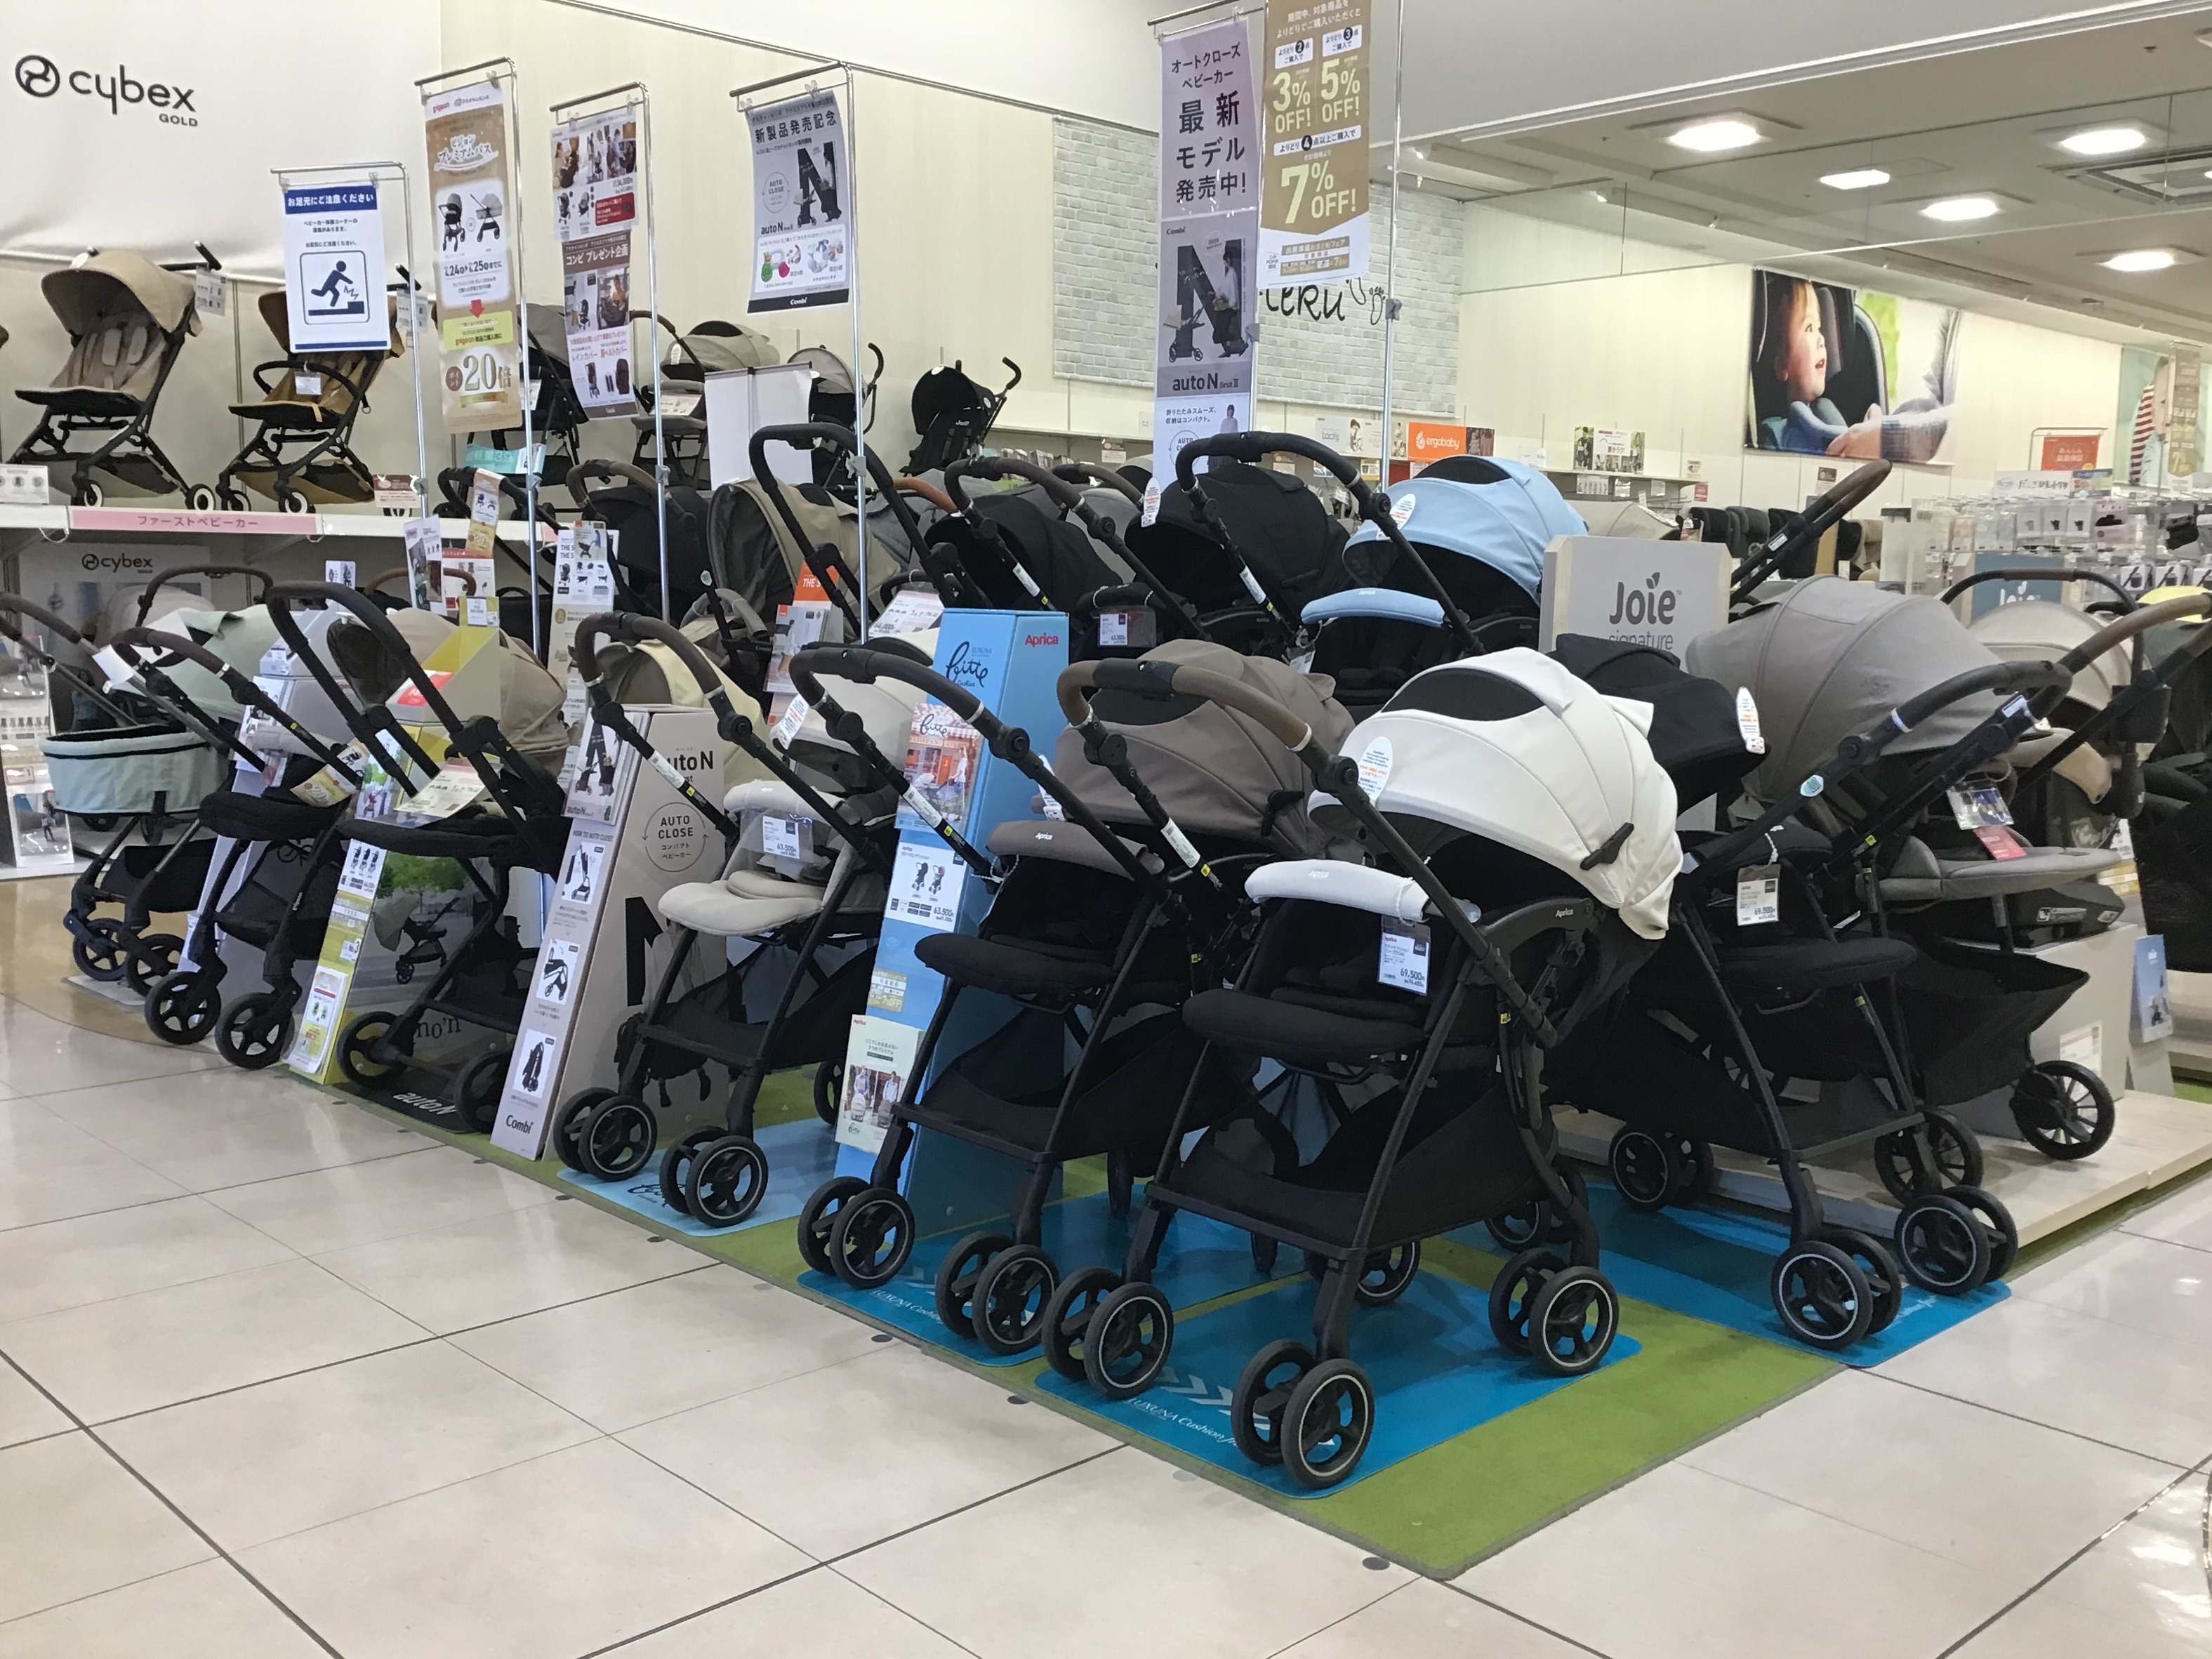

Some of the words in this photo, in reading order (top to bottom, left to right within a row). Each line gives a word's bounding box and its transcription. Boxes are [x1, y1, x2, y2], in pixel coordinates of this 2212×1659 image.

[1276, 8, 1360, 38] よりどりでご購入いただくと
[1171, 43, 1241, 73] オートクローズ
[69, 64, 196, 115] cybex
[1182, 71, 1233, 89] ベビーカー
[1273, 72, 1311, 112] 3%
[1320, 58, 1360, 100] 5%
[159, 113, 198, 127] GOLD
[1179, 90, 1240, 134] 最新
[1275, 107, 1311, 133] OFF!
[1321, 96, 1360, 123] OFF!
[755, 110, 837, 144] 新製品発売記念
[1177, 136, 1245, 168] モデル
[288, 193, 374, 207] お足元にご注意ください
[1176, 171, 1246, 204] 発売中!
[1281, 160, 1334, 224] 7%
[1311, 188, 1356, 218] OFF!
[790, 297, 807, 305] Combi
[463, 353, 497, 391] 20
[1426, 437, 1460, 450] ergobaby
[138, 516, 259, 529] ファーストベビーカー
[100, 553, 153, 573] cybex
[1609, 573, 1676, 625] Joie
[1025, 633, 1059, 647] Aprica
[658, 827, 694, 839] CLOSE
[660, 815, 690, 826] AUTO
[505, 1114, 534, 1135] Combi
